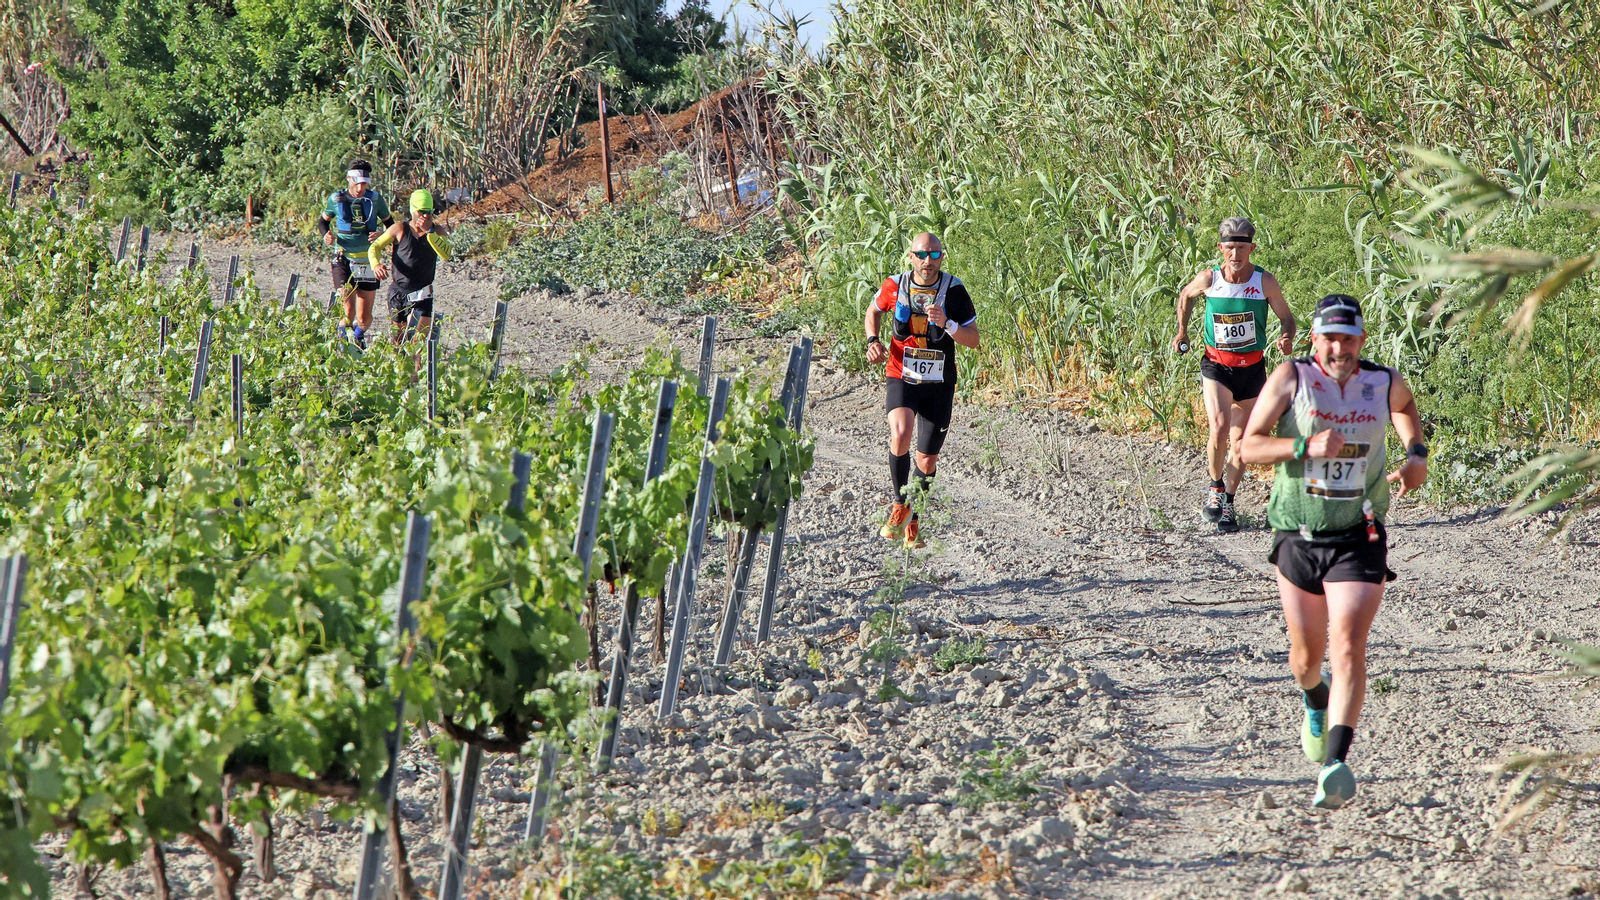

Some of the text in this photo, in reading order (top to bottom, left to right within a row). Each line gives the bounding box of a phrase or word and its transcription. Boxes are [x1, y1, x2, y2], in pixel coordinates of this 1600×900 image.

[1223, 325, 1245, 337] 180
[912, 361, 934, 374] 167
[1309, 410, 1377, 424] maratón
[1322, 461, 1355, 480] 137
